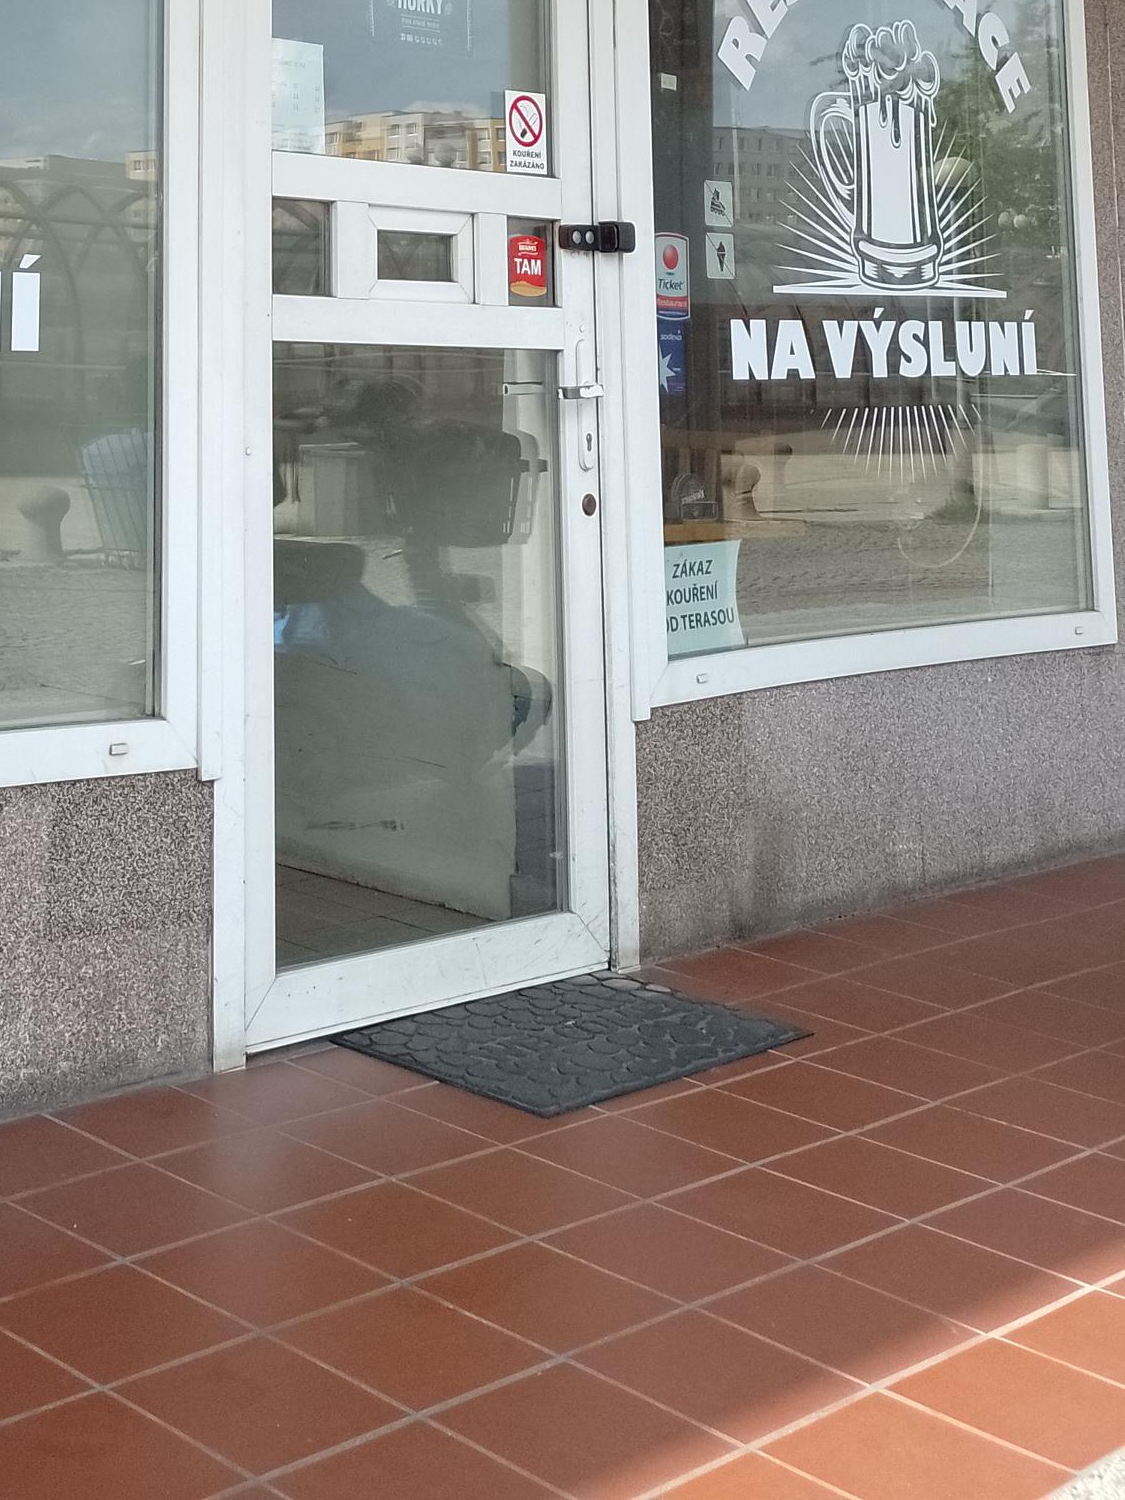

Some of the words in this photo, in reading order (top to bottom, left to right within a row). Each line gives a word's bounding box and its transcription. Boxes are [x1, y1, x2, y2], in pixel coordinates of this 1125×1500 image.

[514, 257, 542, 276] TAM
[658, 278, 684, 291] Ticket
[730, 318, 816, 380] NA
[821, 307, 1038, 379] VÝSLUNÍ
[672, 558, 713, 579] ZÁKAZ
[666, 580, 718, 606] KOUŘENÍ
[680, 607, 734, 630] TERASOU
